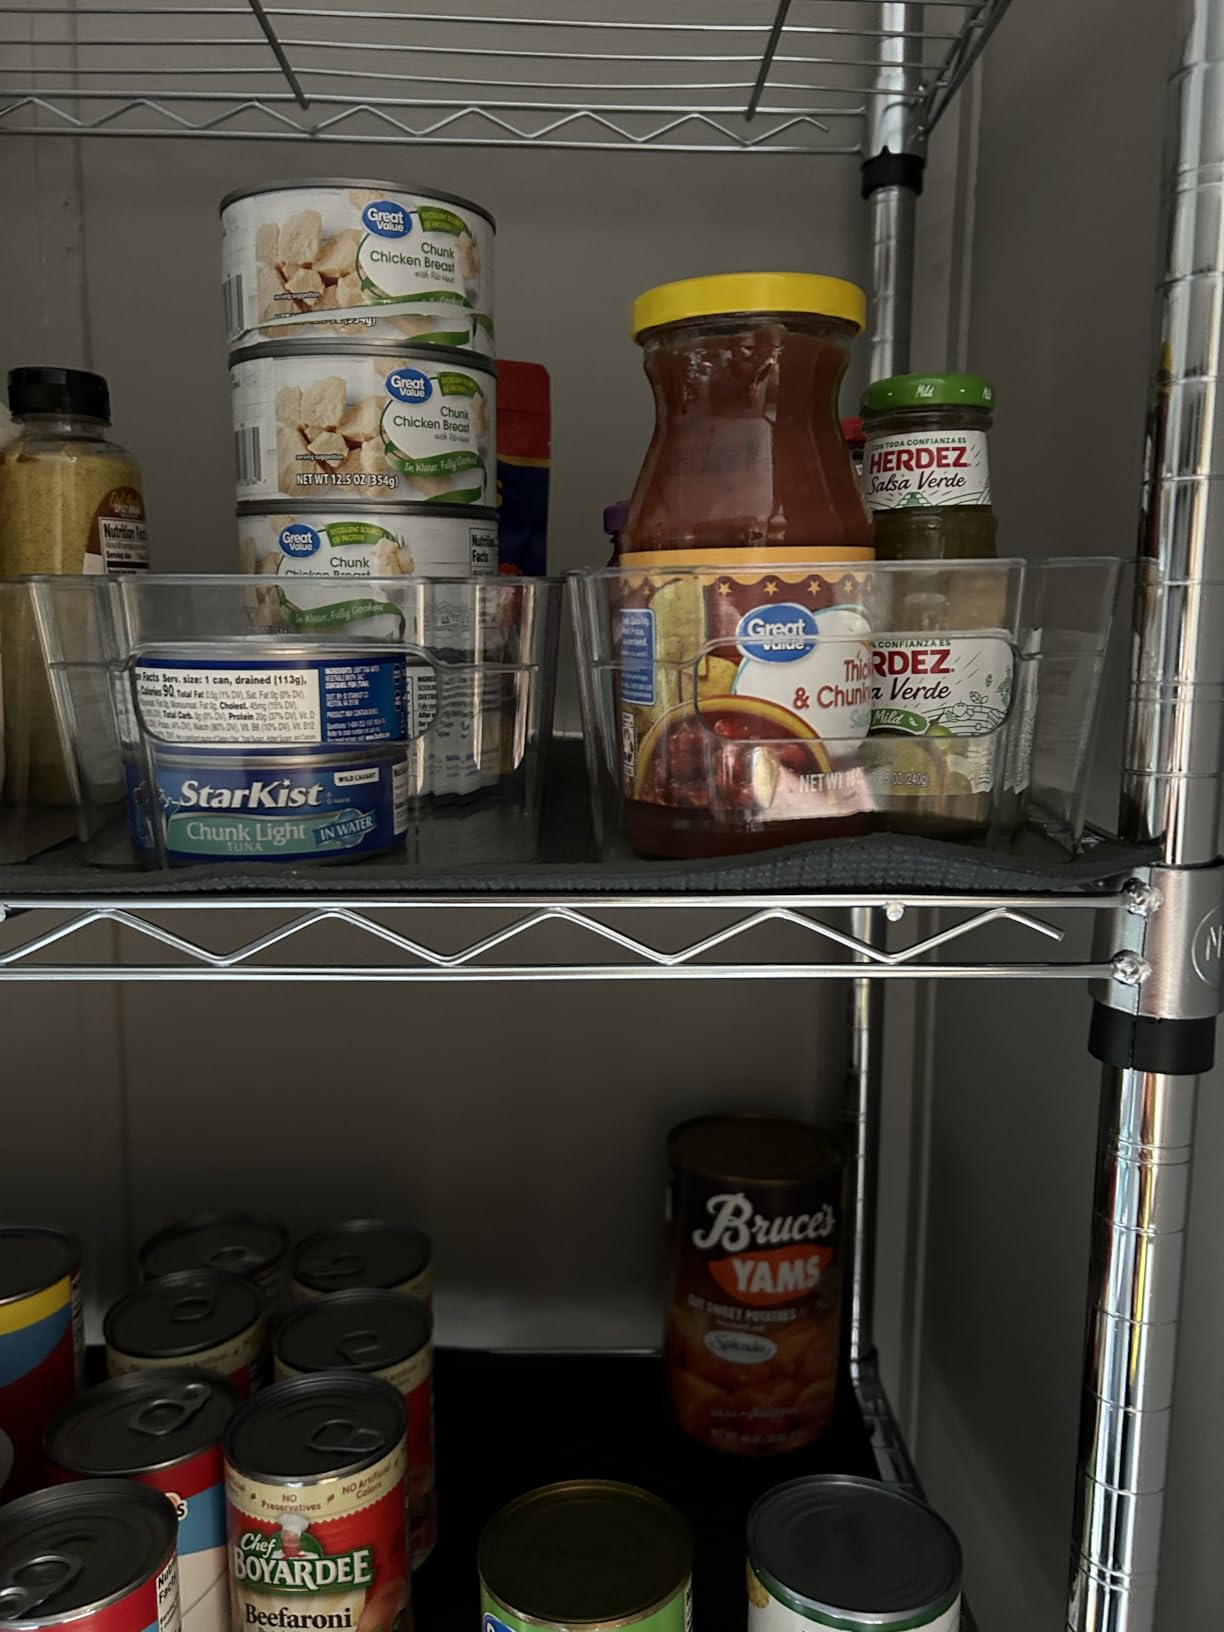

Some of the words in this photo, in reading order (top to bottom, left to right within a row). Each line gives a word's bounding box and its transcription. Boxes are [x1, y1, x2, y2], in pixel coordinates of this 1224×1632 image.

[367, 207, 404, 223] Great
[376, 218, 405, 232] Value
[421, 242, 455, 259] Chunk
[369, 249, 421, 267] Chicken
[424, 256, 455, 273] Breast
[391, 374, 425, 390] Great
[399, 385, 426, 397] Value
[440, 405, 469, 420] Chunk
[393, 415, 441, 430] Chicken
[443, 419, 470, 433] Breast
[886, 440, 905, 448] TODA
[907, 437, 957, 446] CONFIANZA
[869, 446, 968, 474] HERDEZ
[297, 473, 313, 485] NET
[314, 473, 330, 485] WT
[331, 473, 352, 485] 12.5
[353, 473, 366, 485] OZ
[367, 473, 398, 489] (354g)
[868, 473, 912, 495] Salsa
[917, 470, 967, 490] Verde
[104, 523, 135, 538] Nutrition
[282, 531, 313, 544] Great
[290, 541, 313, 551] Value
[330, 556, 370, 568] Chunk
[472, 550, 489, 562] Facts
[747, 618, 806, 638] Great
[878, 640, 937, 649] CONFIANZA
[940, 639, 952, 647] ES
[872, 649, 953, 677] RDEZ
[142, 671, 160, 682] Facts
[163, 673, 182, 683] Serv.
[183, 674, 203, 684] size:
[205, 675, 210, 684] 1
[212, 676, 232, 686] can,
[235, 675, 271, 684] drained
[177, 689, 192, 698] Total
[193, 689, 205, 698] Fat
[890, 677, 952, 700] Verde
[793, 687, 810, 709] &
[229, 711, 254, 720] Protein
[872, 709, 904, 726] Mild
[338, 774, 354, 783] WILD
[355, 771, 376, 781] CAUGHT
[799, 773, 825, 793] NET
[180, 779, 322, 809] StarKist
[186, 821, 250, 841] Chunk
[255, 821, 307, 846] Light
[320, 827, 337, 841] IN
[336, 815, 374, 836] WATER
[226, 841, 264, 853] TUNA
[691, 1190, 837, 1253] Bruce's
[731, 1253, 821, 1295] YAMS
[342, 1482, 357, 1495] NO
[262, 1500, 321, 1512] Preservatives
[282, 1493, 297, 1503] NO
[240, 1532, 277, 1559] Chef
[233, 1546, 373, 1591] BOYARDEE
[245, 1603, 353, 1629] Beefaroni
